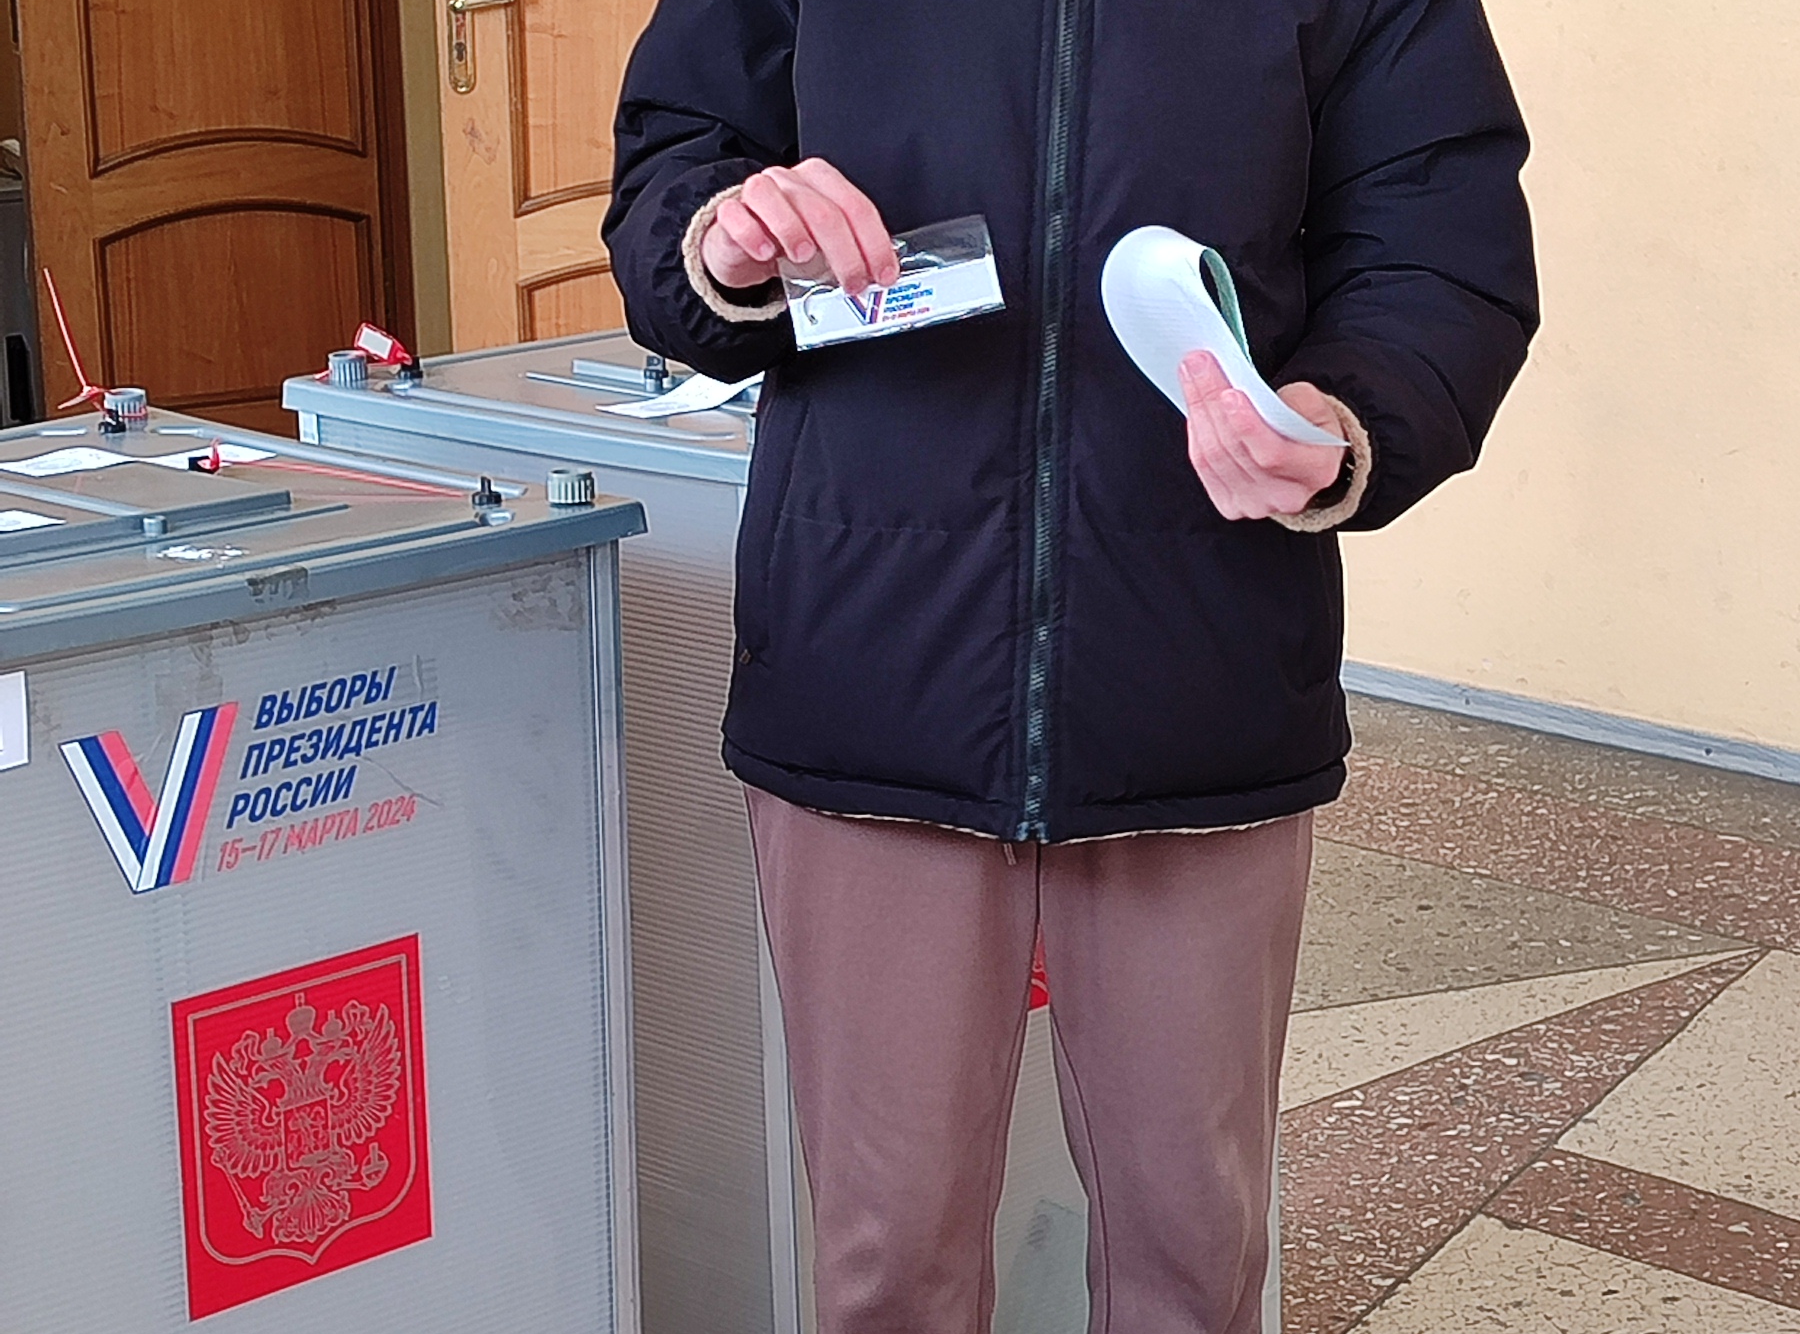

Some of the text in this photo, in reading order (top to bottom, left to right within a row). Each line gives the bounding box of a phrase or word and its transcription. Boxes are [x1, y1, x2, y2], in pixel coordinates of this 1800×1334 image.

[253, 666, 397, 730] ВЫБОРЫ
[239, 701, 437, 780] ПРЕЗИДЕНТА
[226, 765, 357, 829] РОССИИ
[282, 807, 359, 855] МАРТА
[363, 792, 417, 833] 2024
